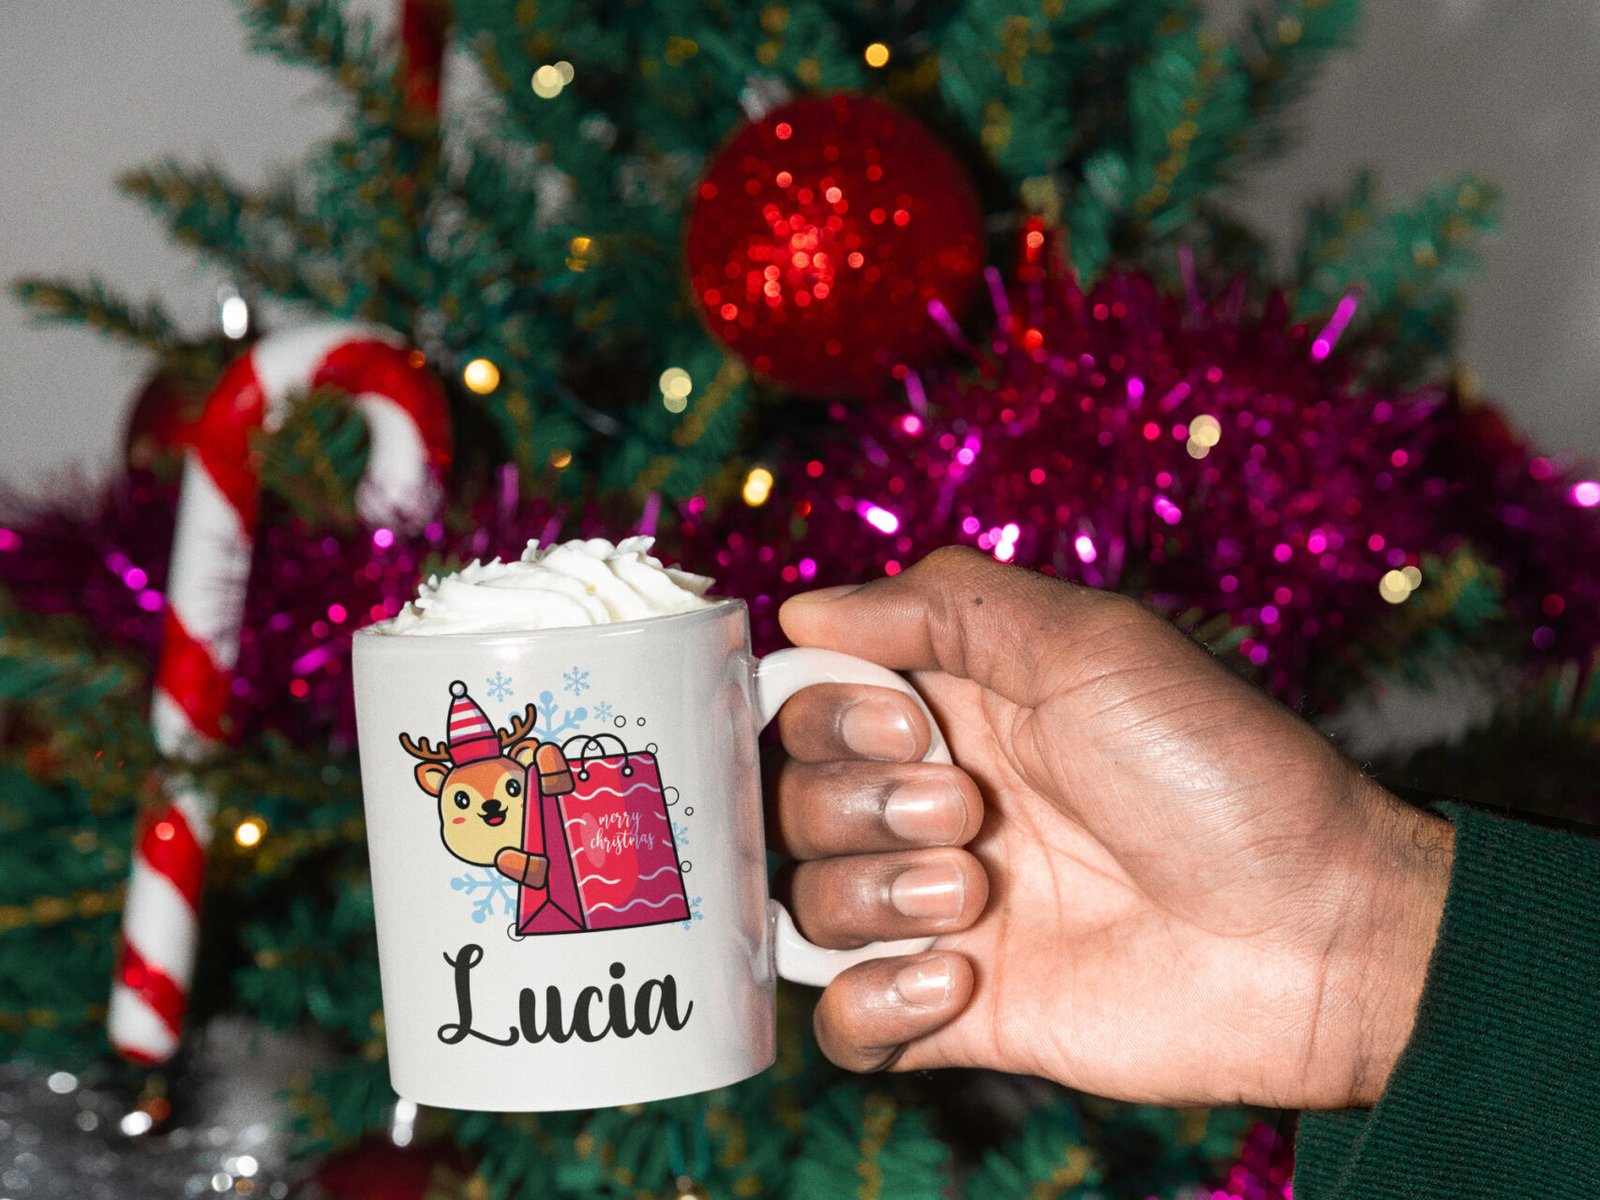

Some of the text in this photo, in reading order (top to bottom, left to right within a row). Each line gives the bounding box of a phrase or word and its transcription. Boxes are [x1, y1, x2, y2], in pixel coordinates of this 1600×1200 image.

[599, 811, 641, 834] merry
[590, 828, 655, 855] christmas
[437, 943, 694, 1047] Lucia
